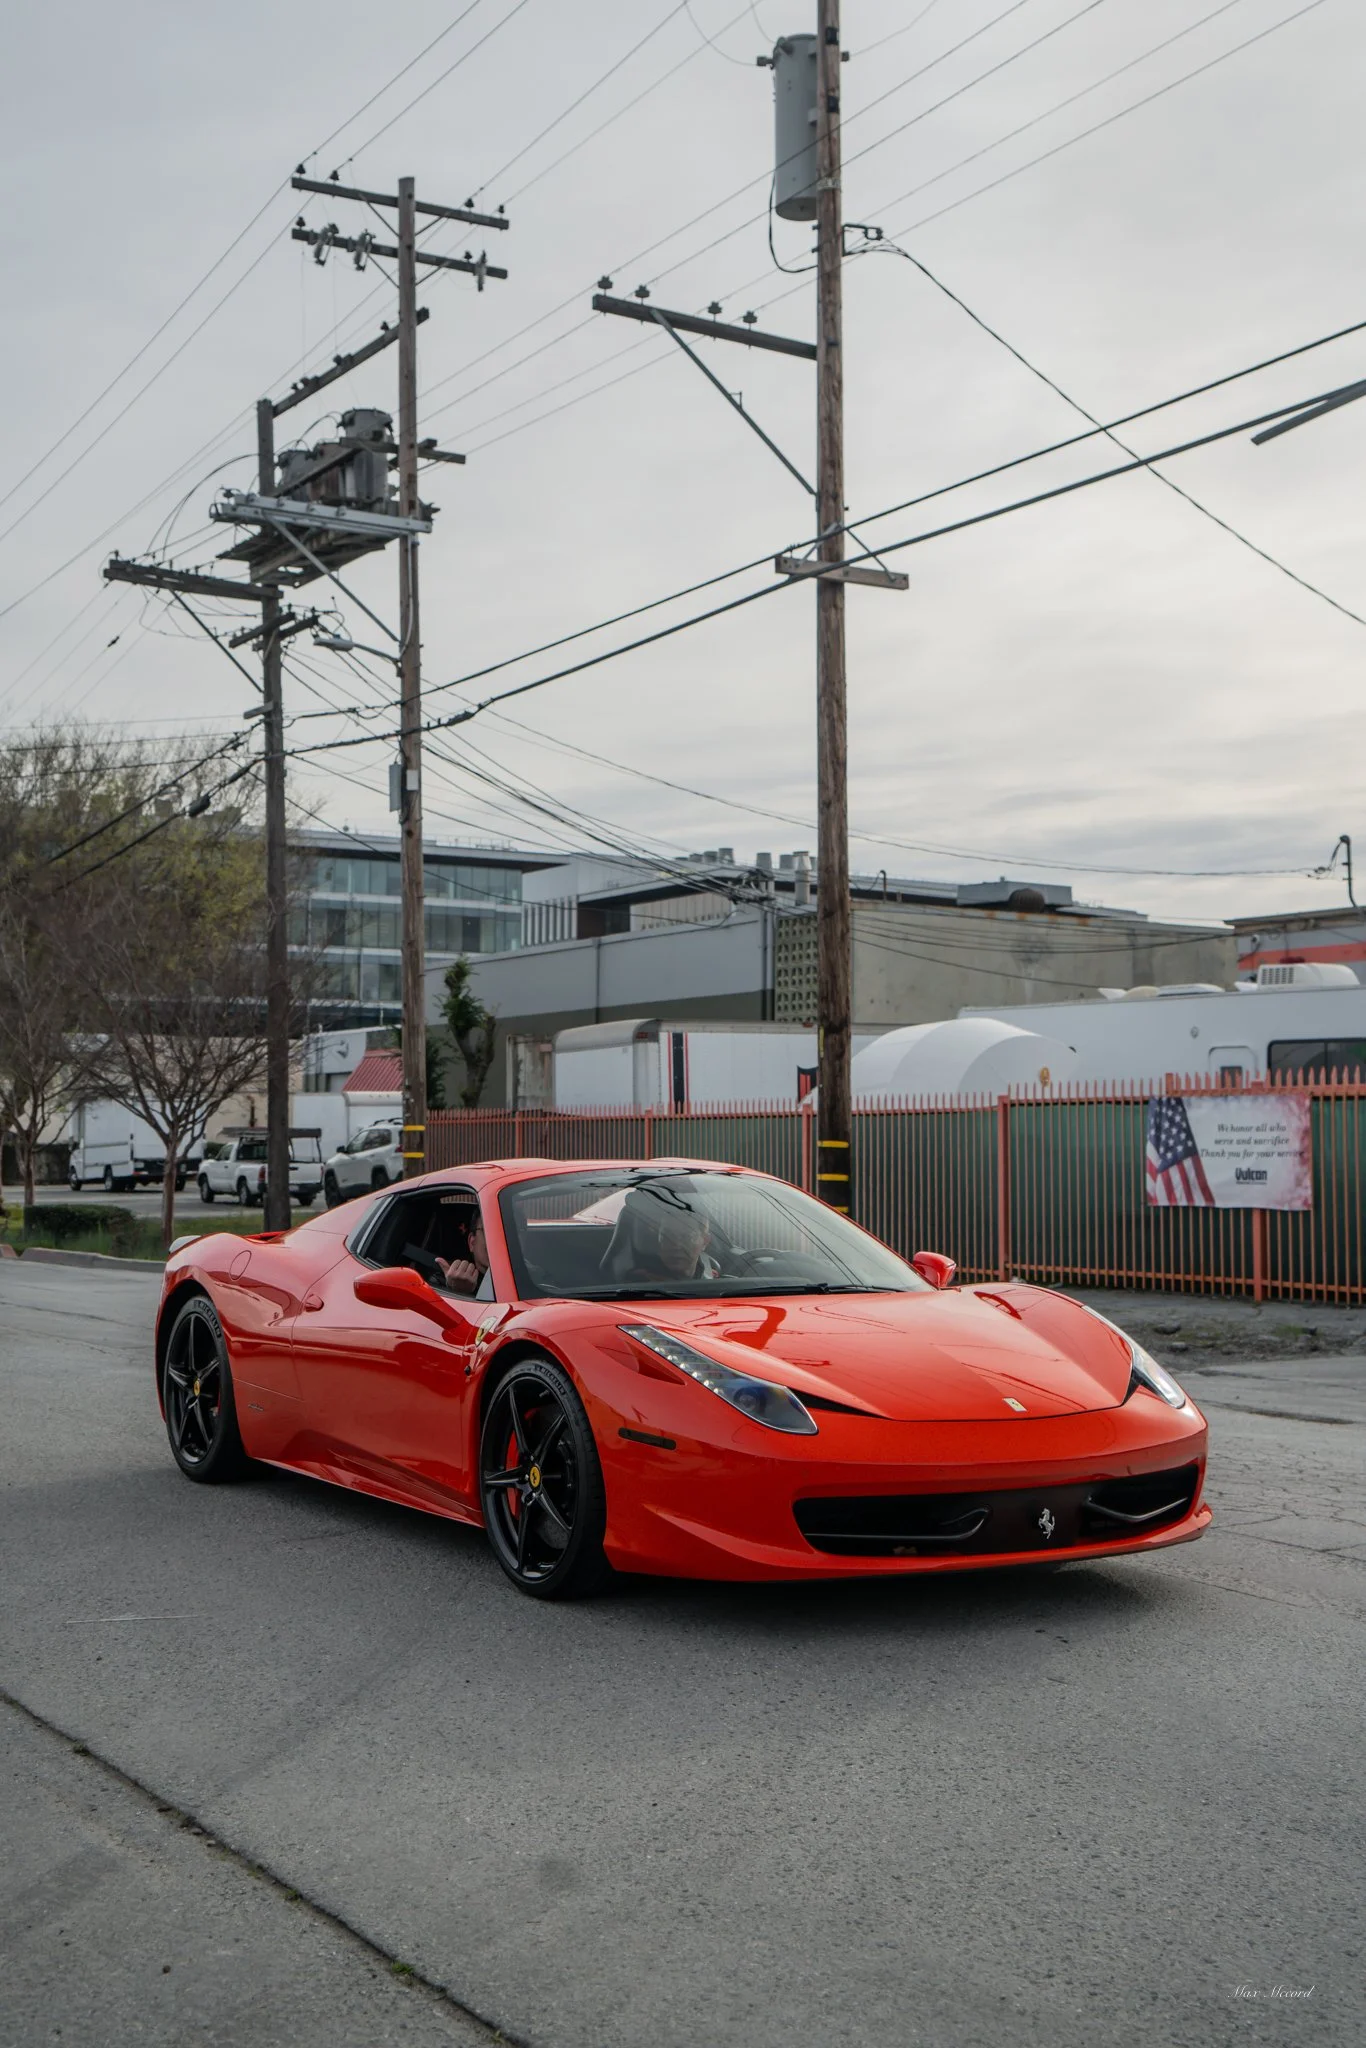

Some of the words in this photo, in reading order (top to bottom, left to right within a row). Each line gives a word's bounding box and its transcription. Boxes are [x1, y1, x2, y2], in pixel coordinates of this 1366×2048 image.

[1217, 1123, 1228, 1132] We
[1230, 1123, 1253, 1132] honor
[1255, 1123, 1267, 1132] all
[1269, 1123, 1287, 1132] who
[1236, 1136, 1252, 1145] and
[1254, 1136, 1290, 1147] sacrifice
[1200, 1148, 1226, 1158] Thank
[1227, 1150, 1241, 1160] you
[1242, 1148, 1255, 1160] for
[1256, 1150, 1275, 1159] your
[1235, 1167, 1268, 1181] Vulcan
